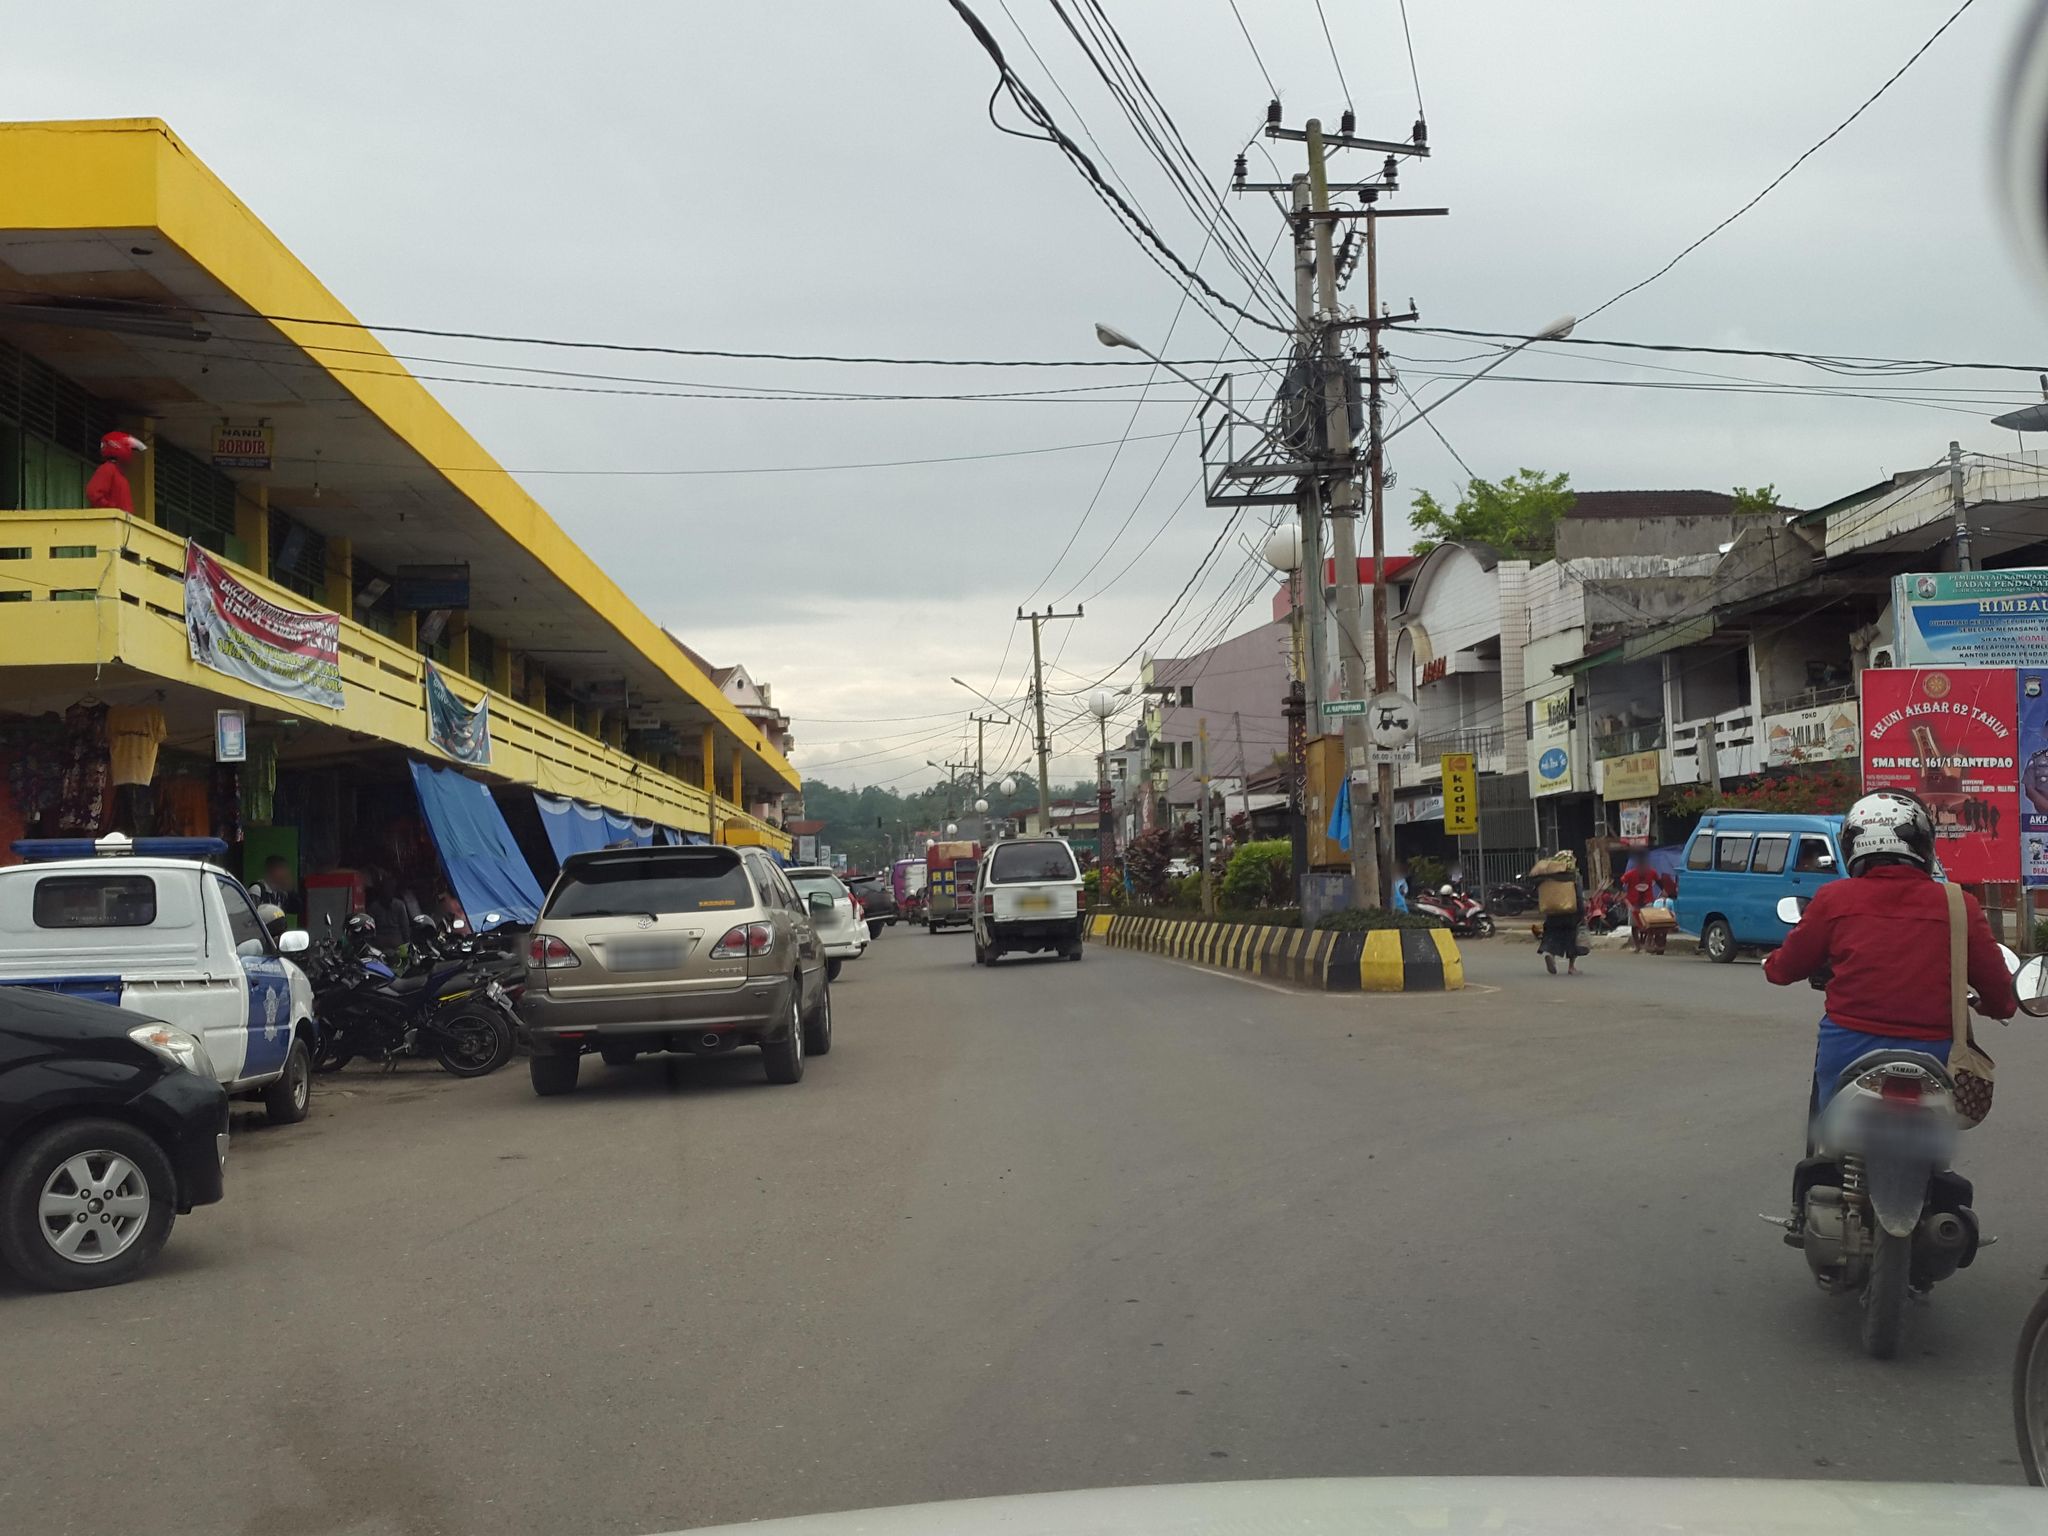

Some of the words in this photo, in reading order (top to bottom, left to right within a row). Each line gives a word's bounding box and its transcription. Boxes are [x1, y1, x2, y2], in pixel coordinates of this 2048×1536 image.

[218, 439, 266, 455] BORDIR
[1870, 709, 1904, 740] REUNI
[1905, 701, 1950, 718] AKBAR
[1953, 703, 1968, 716] 62
[1971, 706, 2009, 739] TAHUN
[1872, 757, 1896, 768] SMA
[1897, 757, 1923, 768] NEG.
[1925, 757, 1951, 769] 161/1
[1953, 757, 2013, 769] RANTEPAO
[1453, 774, 1466, 824] kodak
[1861, 817, 1897, 826] GALAXY
[1892, 1066, 1919, 1074] YAMAHA
